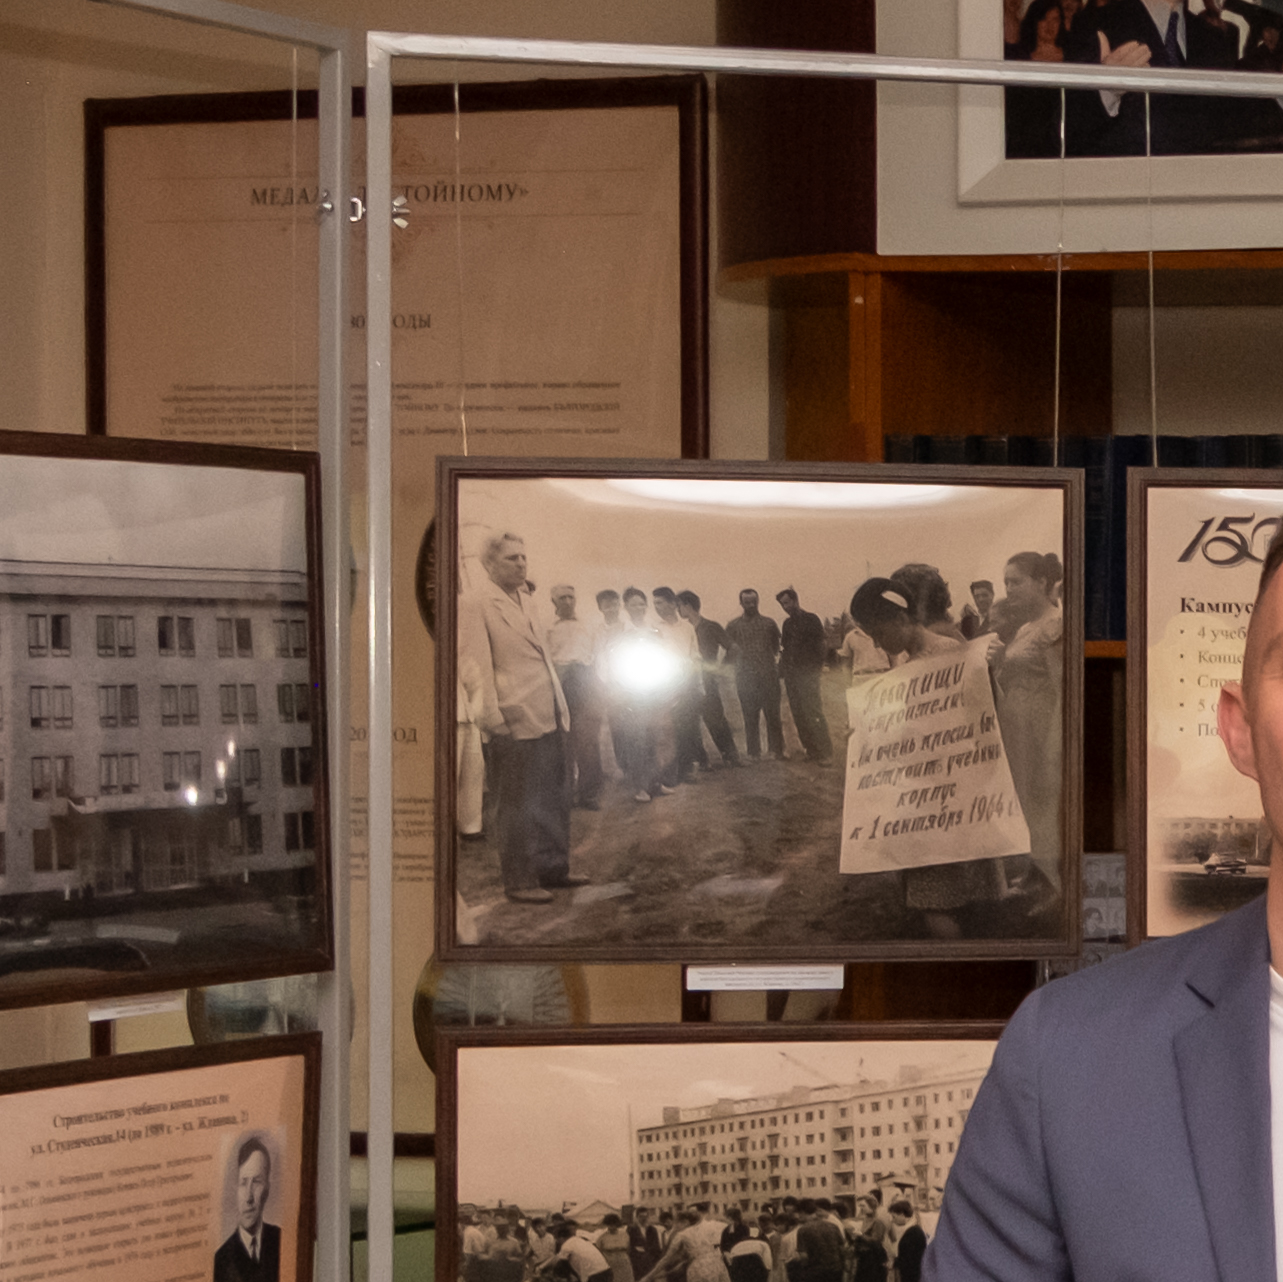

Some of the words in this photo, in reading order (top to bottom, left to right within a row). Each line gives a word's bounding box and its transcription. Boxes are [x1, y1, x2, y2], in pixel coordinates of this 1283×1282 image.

[392, 313, 432, 330] ОДЫ
[1210, 626, 1247, 643] учеб
[896, 783, 957, 809] корпус
[882, 805, 964, 837] сентября
